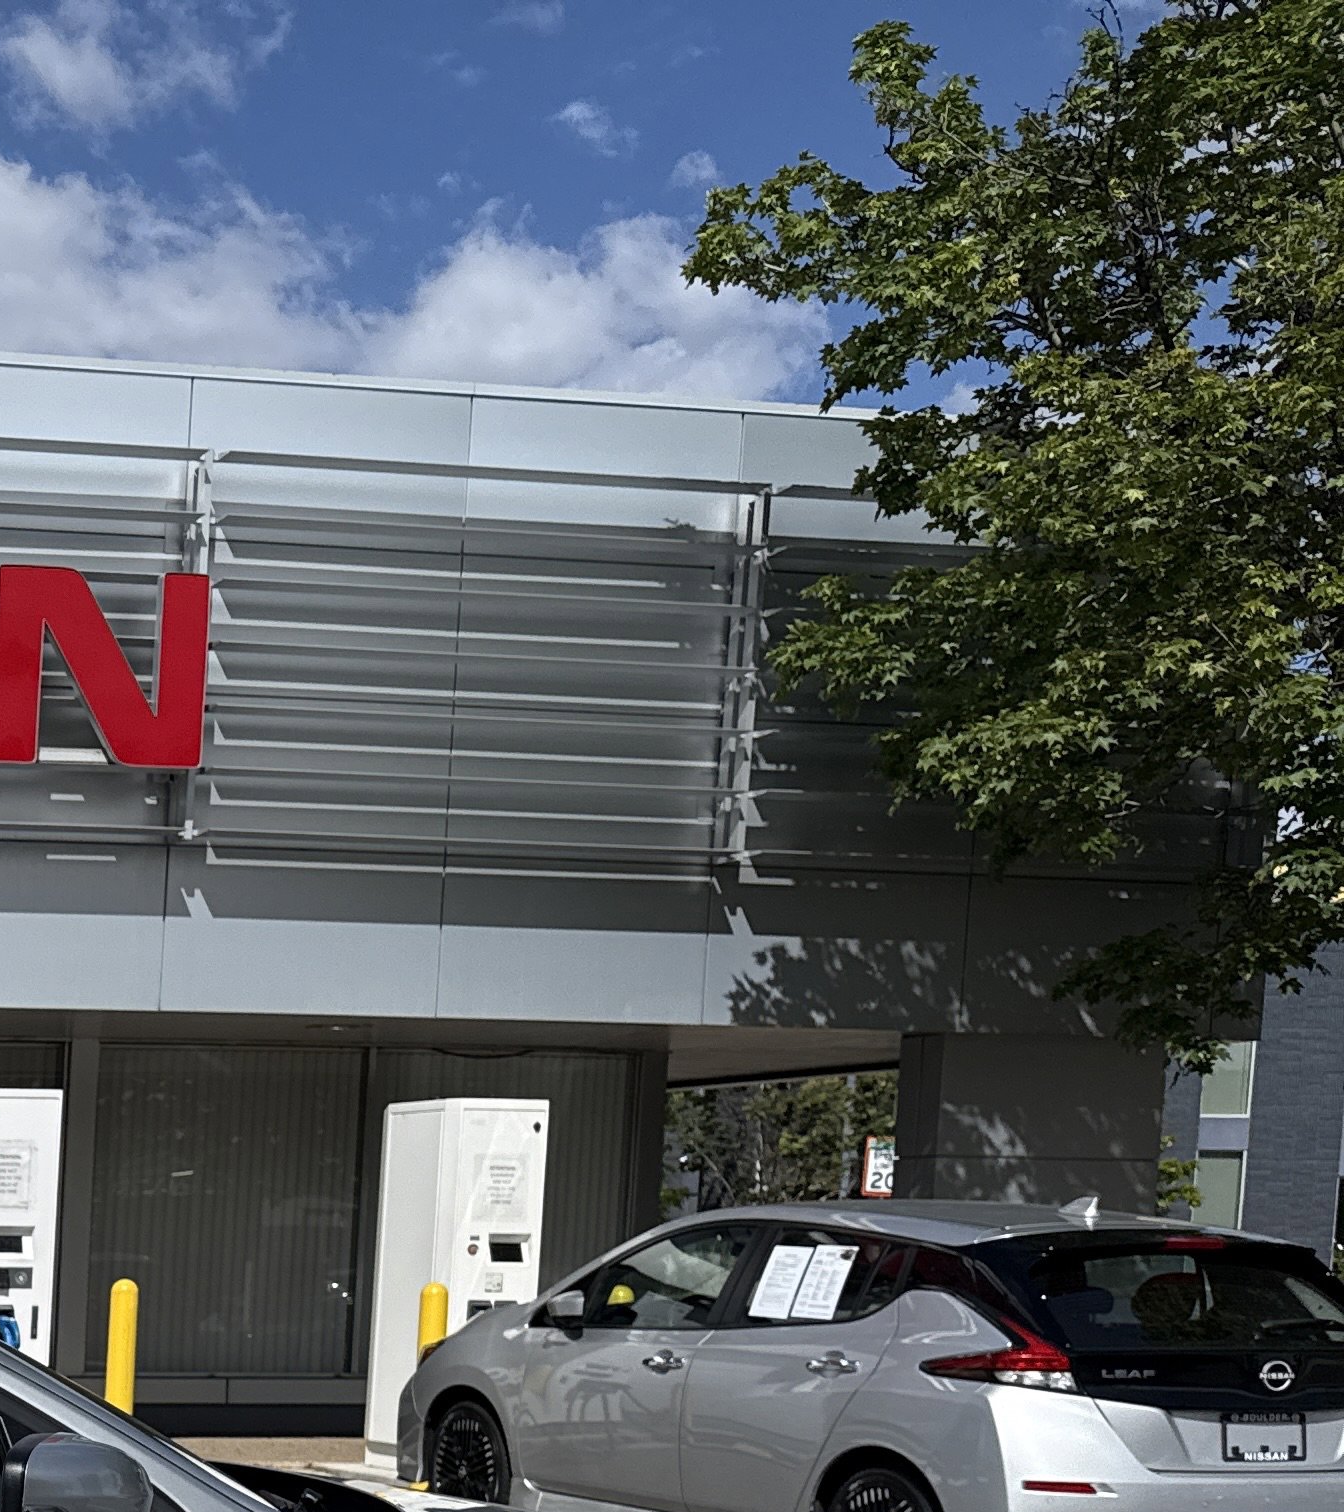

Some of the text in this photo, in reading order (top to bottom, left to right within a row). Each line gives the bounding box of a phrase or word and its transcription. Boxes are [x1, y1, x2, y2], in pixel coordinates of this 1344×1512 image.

[1102, 1369, 1156, 1379] LEAF
[1259, 1372, 1296, 1380] NISSAN
[1242, 1413, 1289, 1423] BOULDER
[1243, 1452, 1289, 1461] NISSAN
